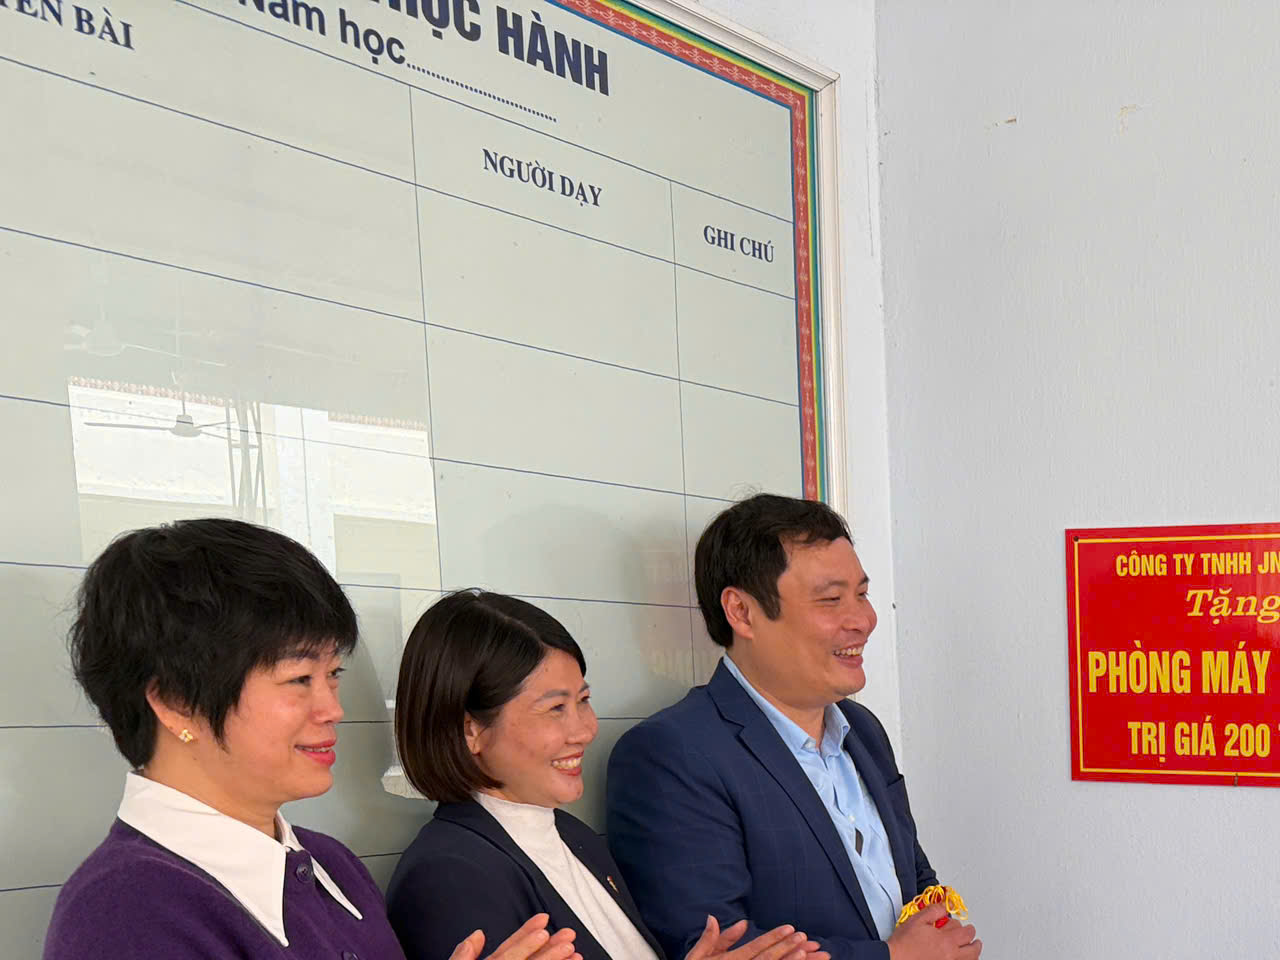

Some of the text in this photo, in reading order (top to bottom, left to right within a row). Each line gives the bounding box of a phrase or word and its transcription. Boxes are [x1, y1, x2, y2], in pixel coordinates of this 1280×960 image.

[72, 5, 136, 51] BÀI
[496, 5, 610, 97] HÀNH
[482, 148, 602, 207] NGƯỜI DẠY
[703, 225, 774, 263] GHI CHÚ
[1115, 550, 1167, 577] CÔNG
[1173, 553, 1195, 576] TY
[1200, 552, 1252, 575] TNHH
[1088, 640, 1191, 694] PHÒNG
[1201, 641, 1271, 694] MÁY
[1127, 722, 1166, 763] TRỊ
[1174, 715, 1216, 757] GIÁ
[1224, 723, 1271, 757] 200
